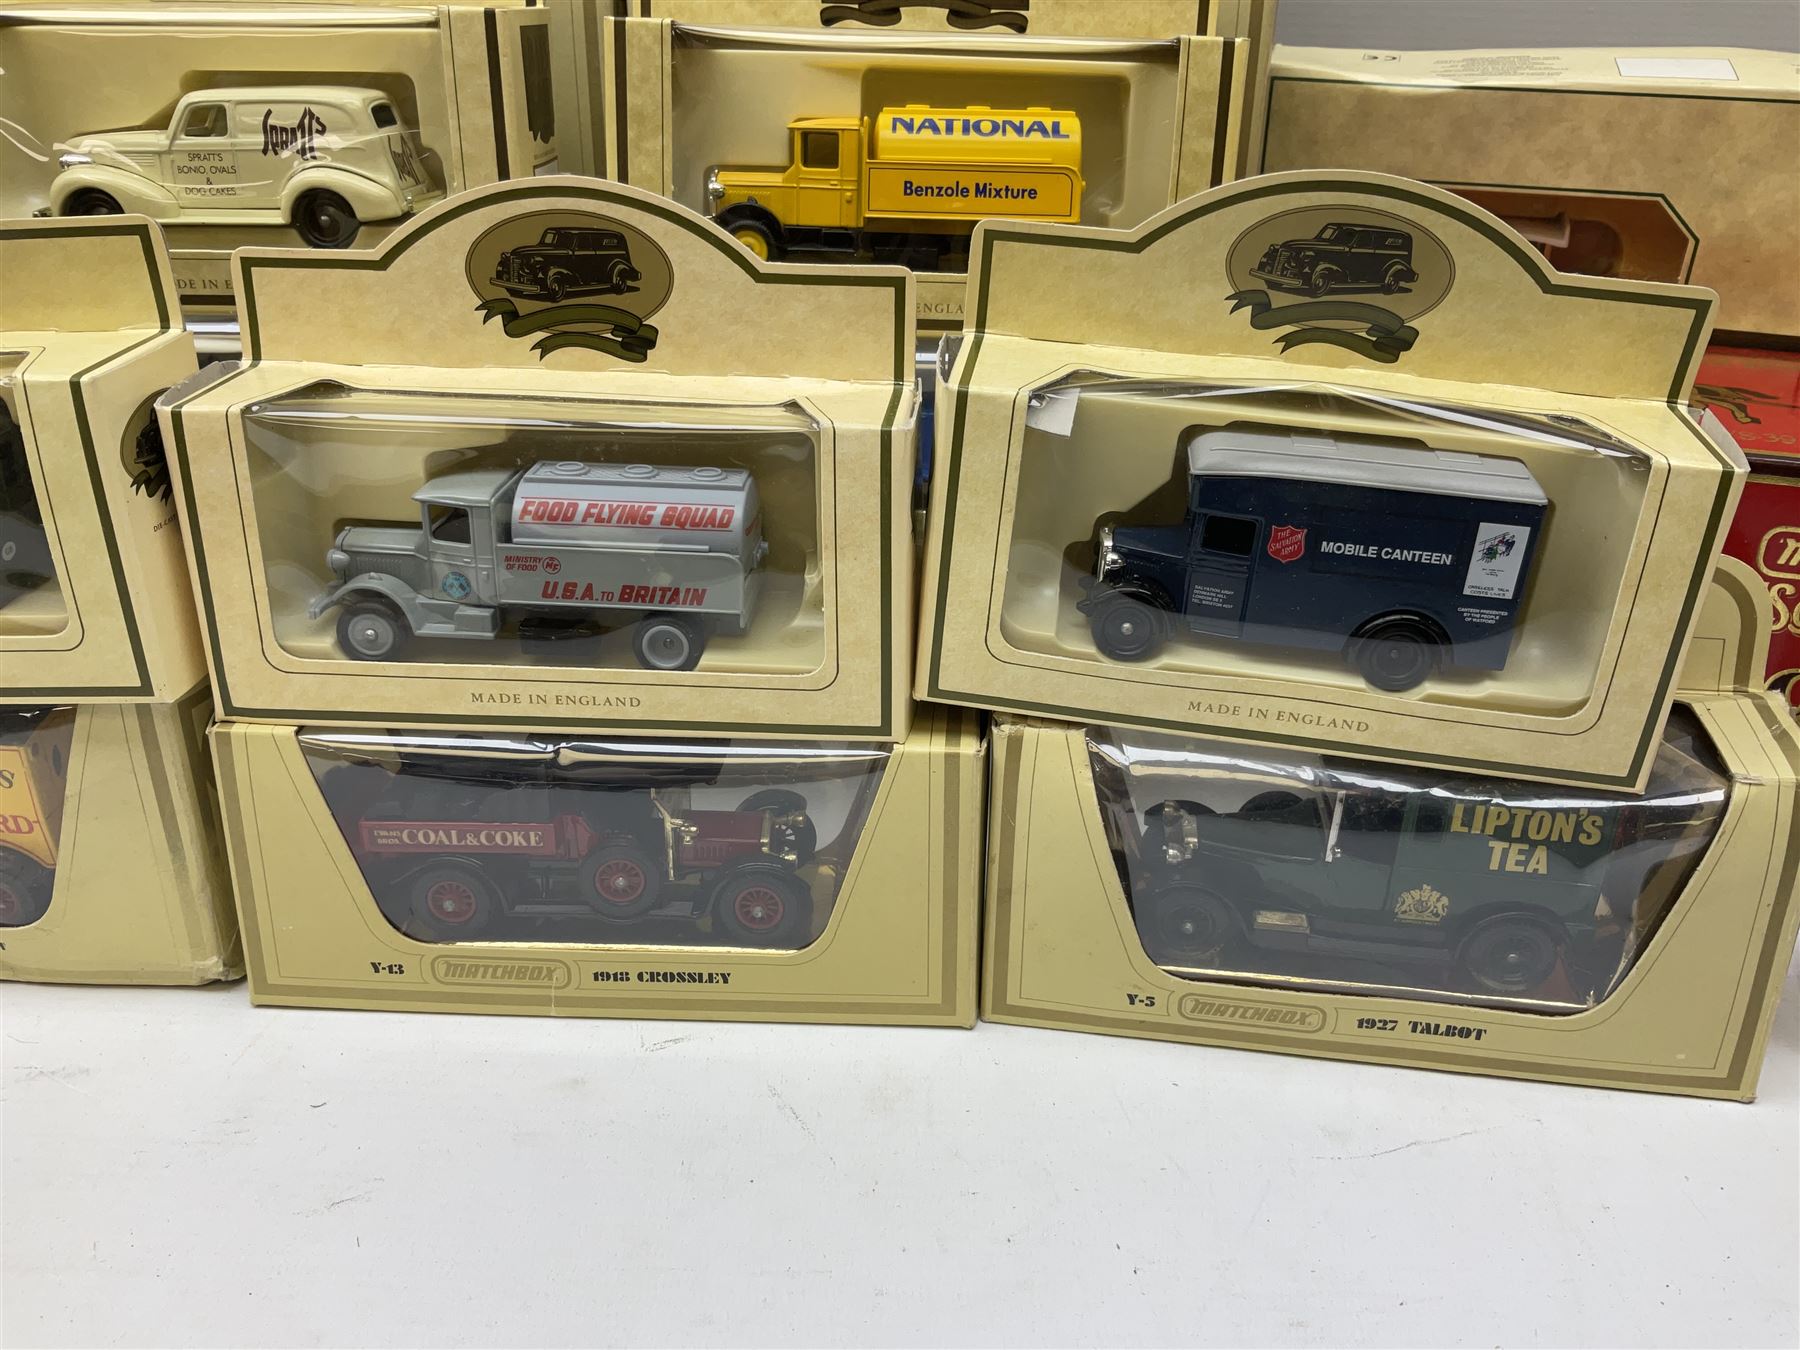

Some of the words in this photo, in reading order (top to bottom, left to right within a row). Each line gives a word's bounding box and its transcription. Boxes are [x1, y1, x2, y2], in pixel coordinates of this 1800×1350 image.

[892, 117, 1070, 139] NATIONAL
[187, 153, 223, 161] SPRATT'S
[210, 165, 237, 174] OVALS
[206, 177, 213, 185] &
[185, 187, 206, 196] DOG
[209, 187, 237, 196] CAKES
[903, 181, 970, 198] Benzole
[974, 182, 1038, 199] Mixture
[202, 279, 218, 289] IN
[518, 500, 580, 523] FOOD
[581, 502, 657, 525] FLYING
[660, 506, 735, 529] SQUAD
[1269, 532, 1303, 551] SALVATION
[1277, 530, 1291, 540] THE
[1280, 543, 1300, 555] ARMY
[1320, 540, 1378, 559] MOBILE
[1381, 547, 1453, 566] CANTEEN
[504, 555, 543, 564] MINISTRY
[505, 563, 517, 571] OF
[517, 564, 538, 572] FOOD
[601, 590, 615, 602] TO
[618, 584, 708, 606] BRITAIN
[471, 693, 522, 704] MADE
[529, 694, 547, 705] IN
[555, 695, 641, 708] ENGLAND
[1188, 701, 1241, 716] MADE
[1248, 707, 1269, 720] IN
[1275, 710, 1370, 733] ENGLAND
[1450, 803, 1604, 846] LIPTON'S
[1488, 841, 1549, 875] TEA
[370, 961, 405, 975] Y-13
[592, 970, 631, 983] 1918
[636, 970, 732, 985] CROSSLEY
[1126, 993, 1157, 1008] Y-5
[1356, 1017, 1399, 1032] 1927
[1408, 1020, 1488, 1042] TALBOT
